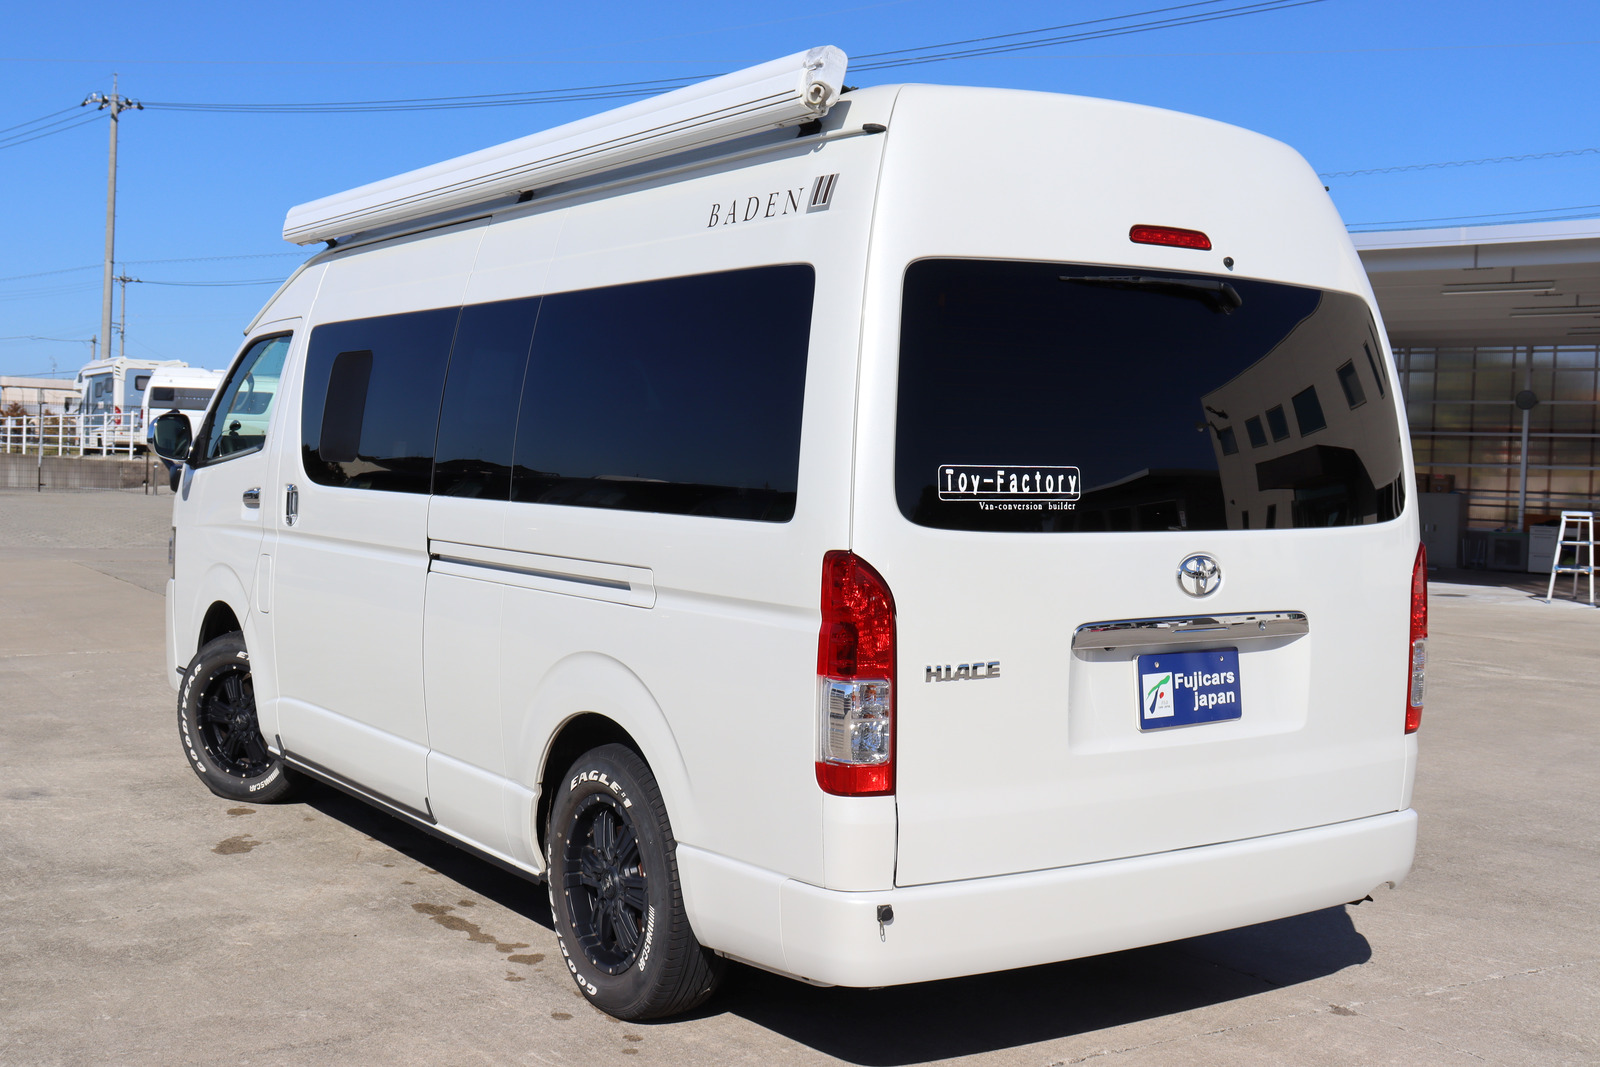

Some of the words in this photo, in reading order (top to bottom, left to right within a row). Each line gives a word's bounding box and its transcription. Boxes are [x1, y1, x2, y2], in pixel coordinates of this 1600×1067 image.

[707, 187, 804, 228] BADEN
[945, 468, 1077, 495] Toy-Factory
[979, 501, 1043, 510] Van-conversion
[1048, 501, 1076, 510] builder
[925, 661, 1000, 683] HIACE
[1174, 671, 1235, 691] Fujicars
[1193, 691, 1236, 711] japan
[570, 769, 622, 794] EAGLE
